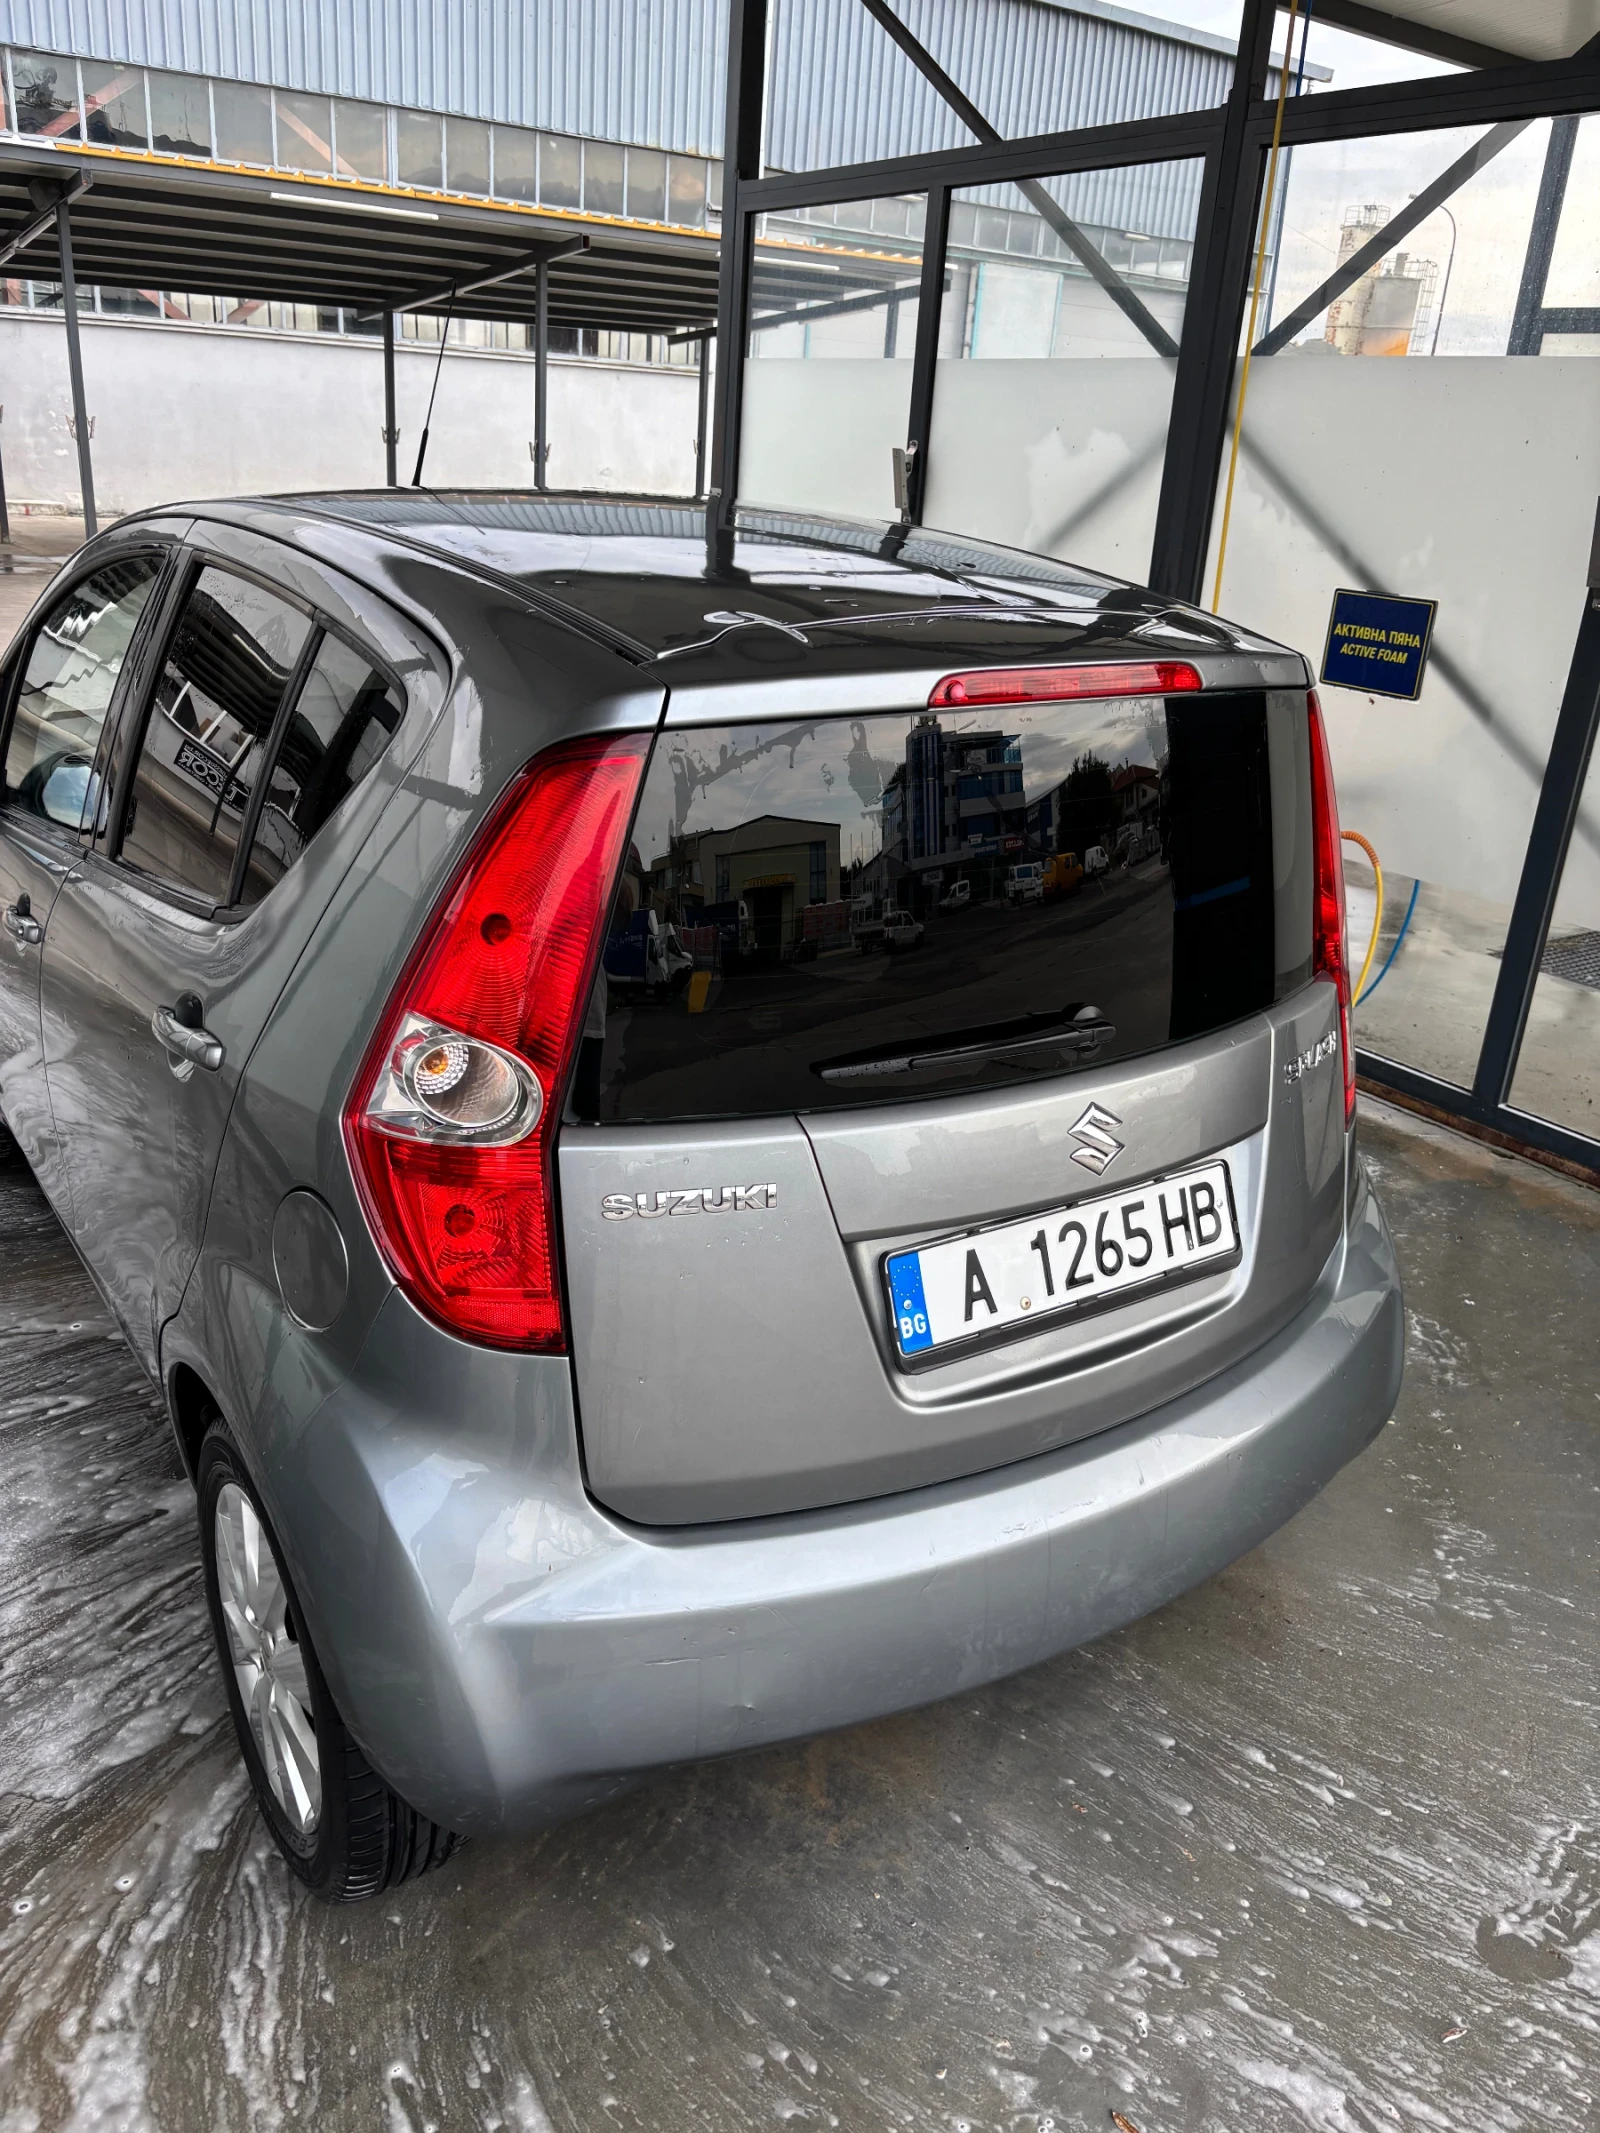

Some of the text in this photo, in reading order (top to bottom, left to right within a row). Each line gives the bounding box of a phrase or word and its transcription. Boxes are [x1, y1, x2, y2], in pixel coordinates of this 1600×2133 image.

[1334, 623, 1421, 648] АКТИВНА ПЯНА
[1340, 643, 1408, 664] ACTIVE FOAM
[1283, 1030, 1337, 1085] SPLASH
[602, 1183, 777, 1221] SUZUKI
[964, 1181, 1222, 1321] A 1265 HB
[899, 1313, 928, 1340] BG
